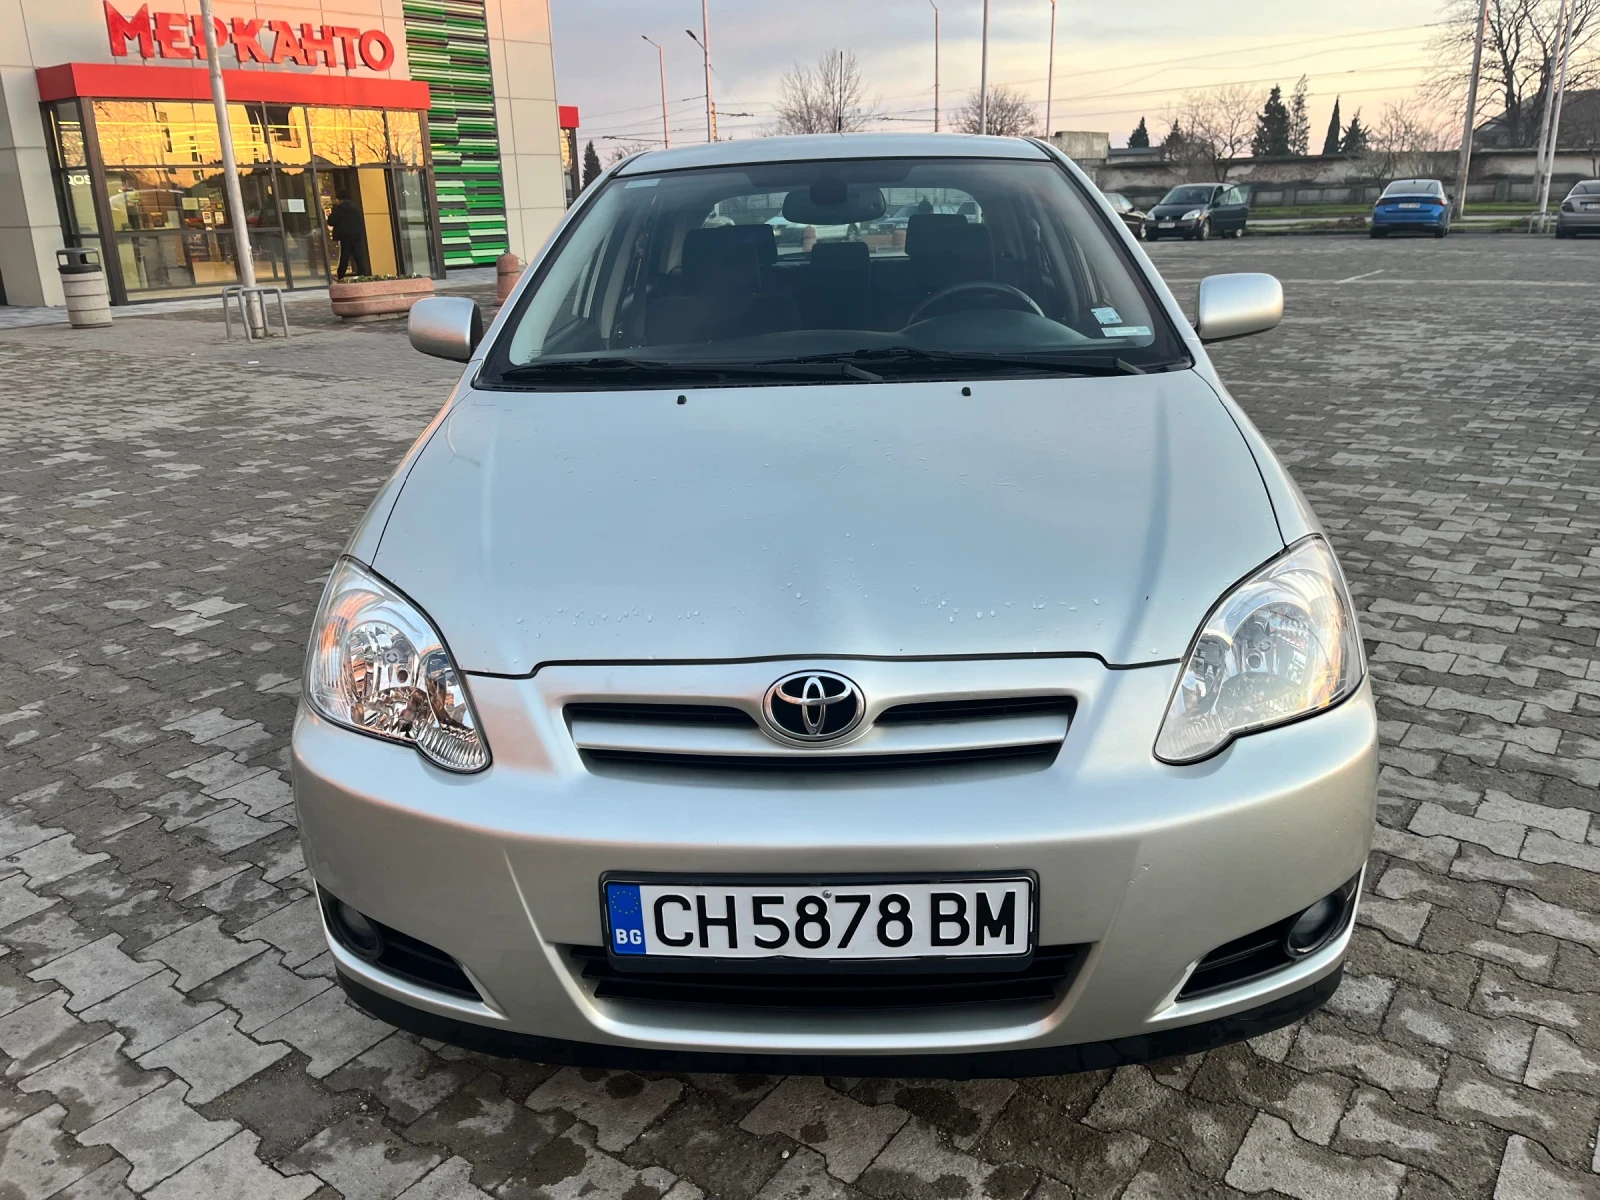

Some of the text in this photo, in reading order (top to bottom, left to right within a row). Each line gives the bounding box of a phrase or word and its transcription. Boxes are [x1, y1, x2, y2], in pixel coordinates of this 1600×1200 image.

[103, 0, 395, 71] МЕРКАНТО
[615, 928, 642, 945] BG
[653, 891, 1016, 949] CH 5878 BM
